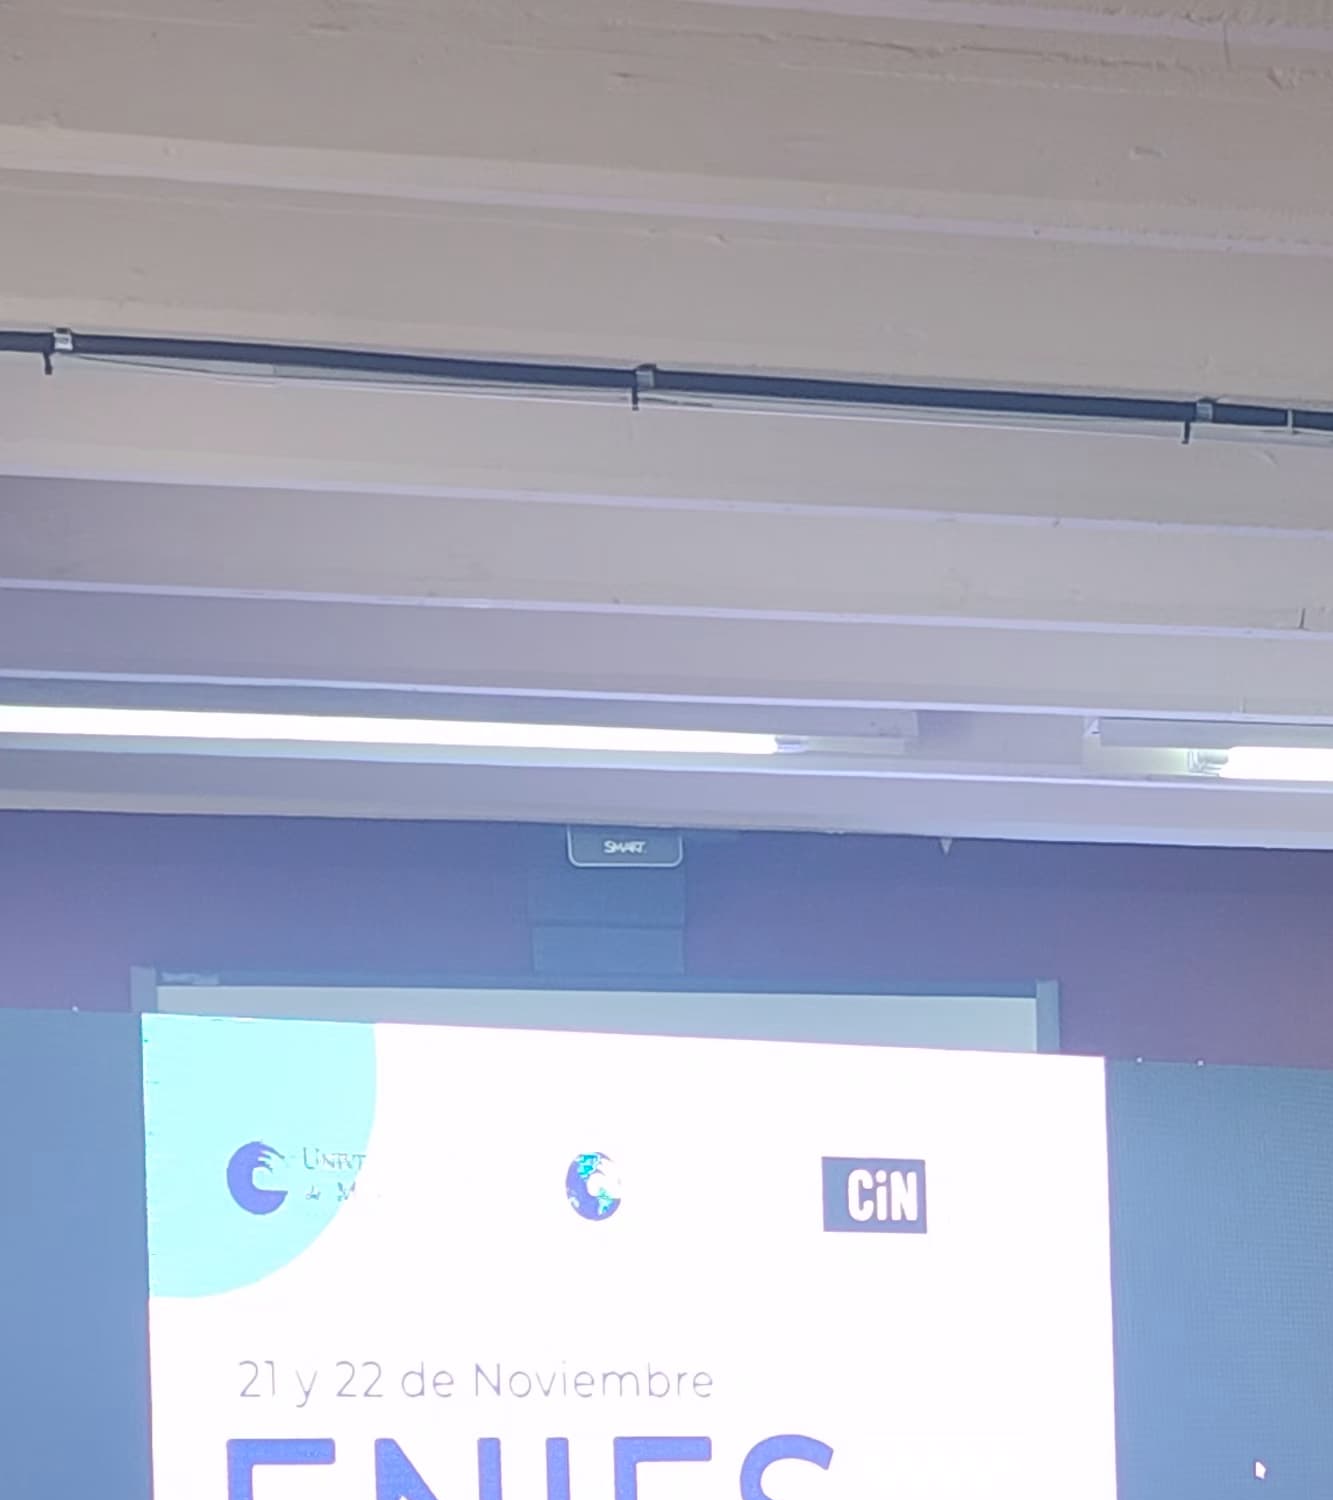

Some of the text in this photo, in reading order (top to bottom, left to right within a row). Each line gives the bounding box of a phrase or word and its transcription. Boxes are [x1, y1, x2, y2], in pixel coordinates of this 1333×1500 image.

[847, 1168, 918, 1222] CiN
[239, 1360, 714, 1408] 21 y 22 de Noviembre
